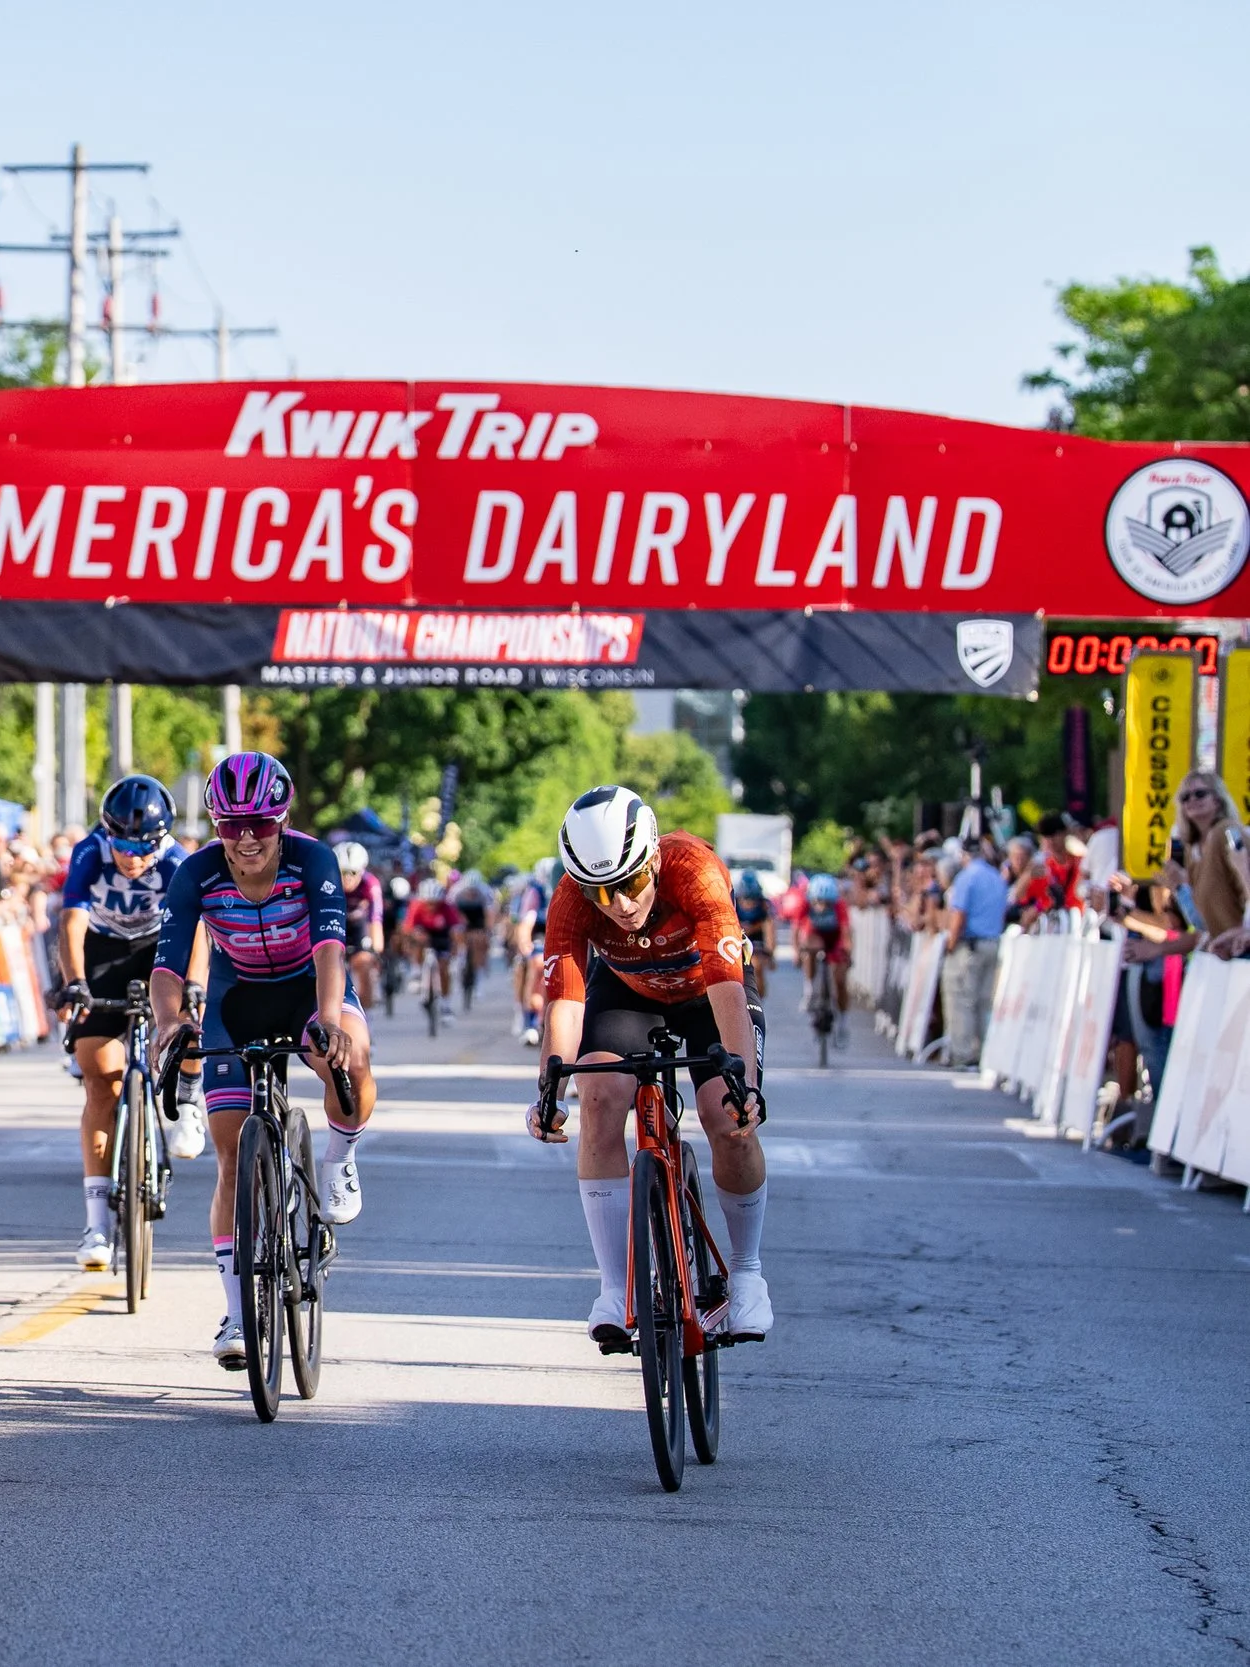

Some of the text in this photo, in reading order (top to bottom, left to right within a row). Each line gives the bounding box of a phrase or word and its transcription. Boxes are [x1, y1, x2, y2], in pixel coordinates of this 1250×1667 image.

[462, 489, 1004, 591] DAIRYLAND
[283, 611, 634, 662] NATIONAL CHAMPIONSHIPS
[260, 665, 655, 687] MASTERS & JUNIOR ROAD WISCONSIN
[1146, 696, 1171, 868] CROSSWALK
